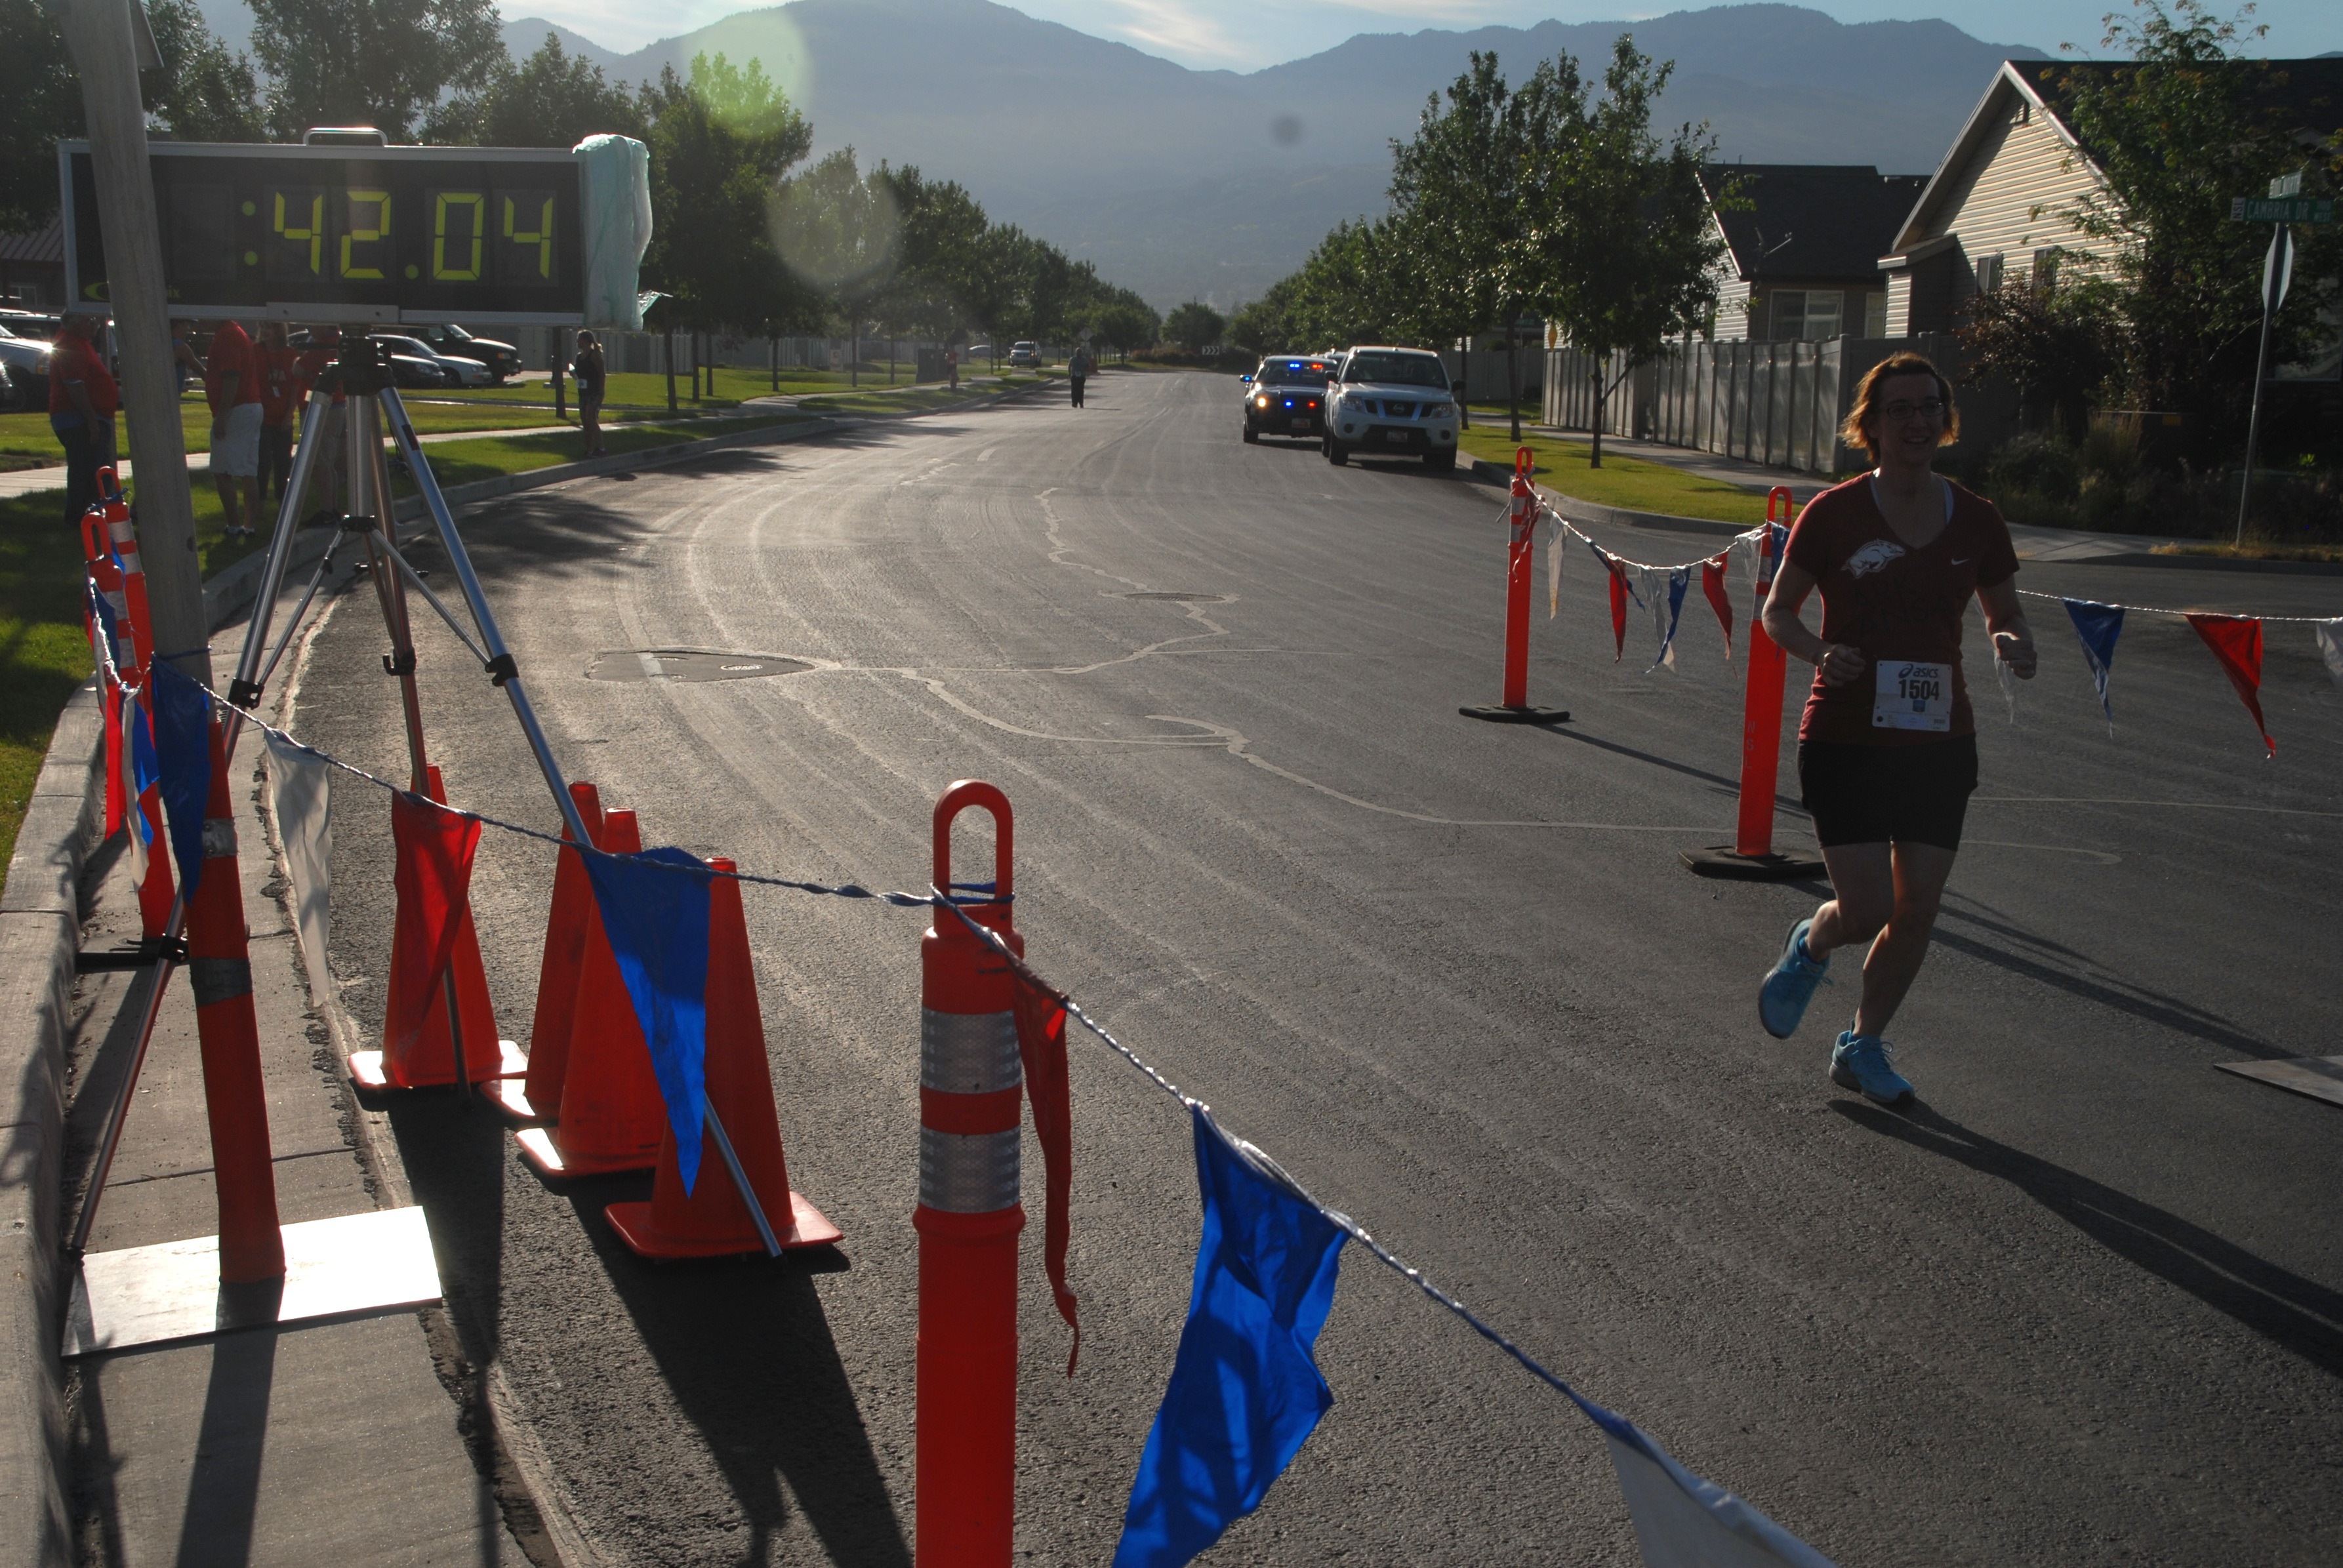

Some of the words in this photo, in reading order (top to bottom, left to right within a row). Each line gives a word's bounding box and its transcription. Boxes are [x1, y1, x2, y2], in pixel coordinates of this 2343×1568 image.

[2233, 199, 2243, 219] NSL
[2247, 201, 2289, 220] CAMBRIA
[2296, 201, 2309, 220] DR
[1898, 679, 1940, 701] 1504
